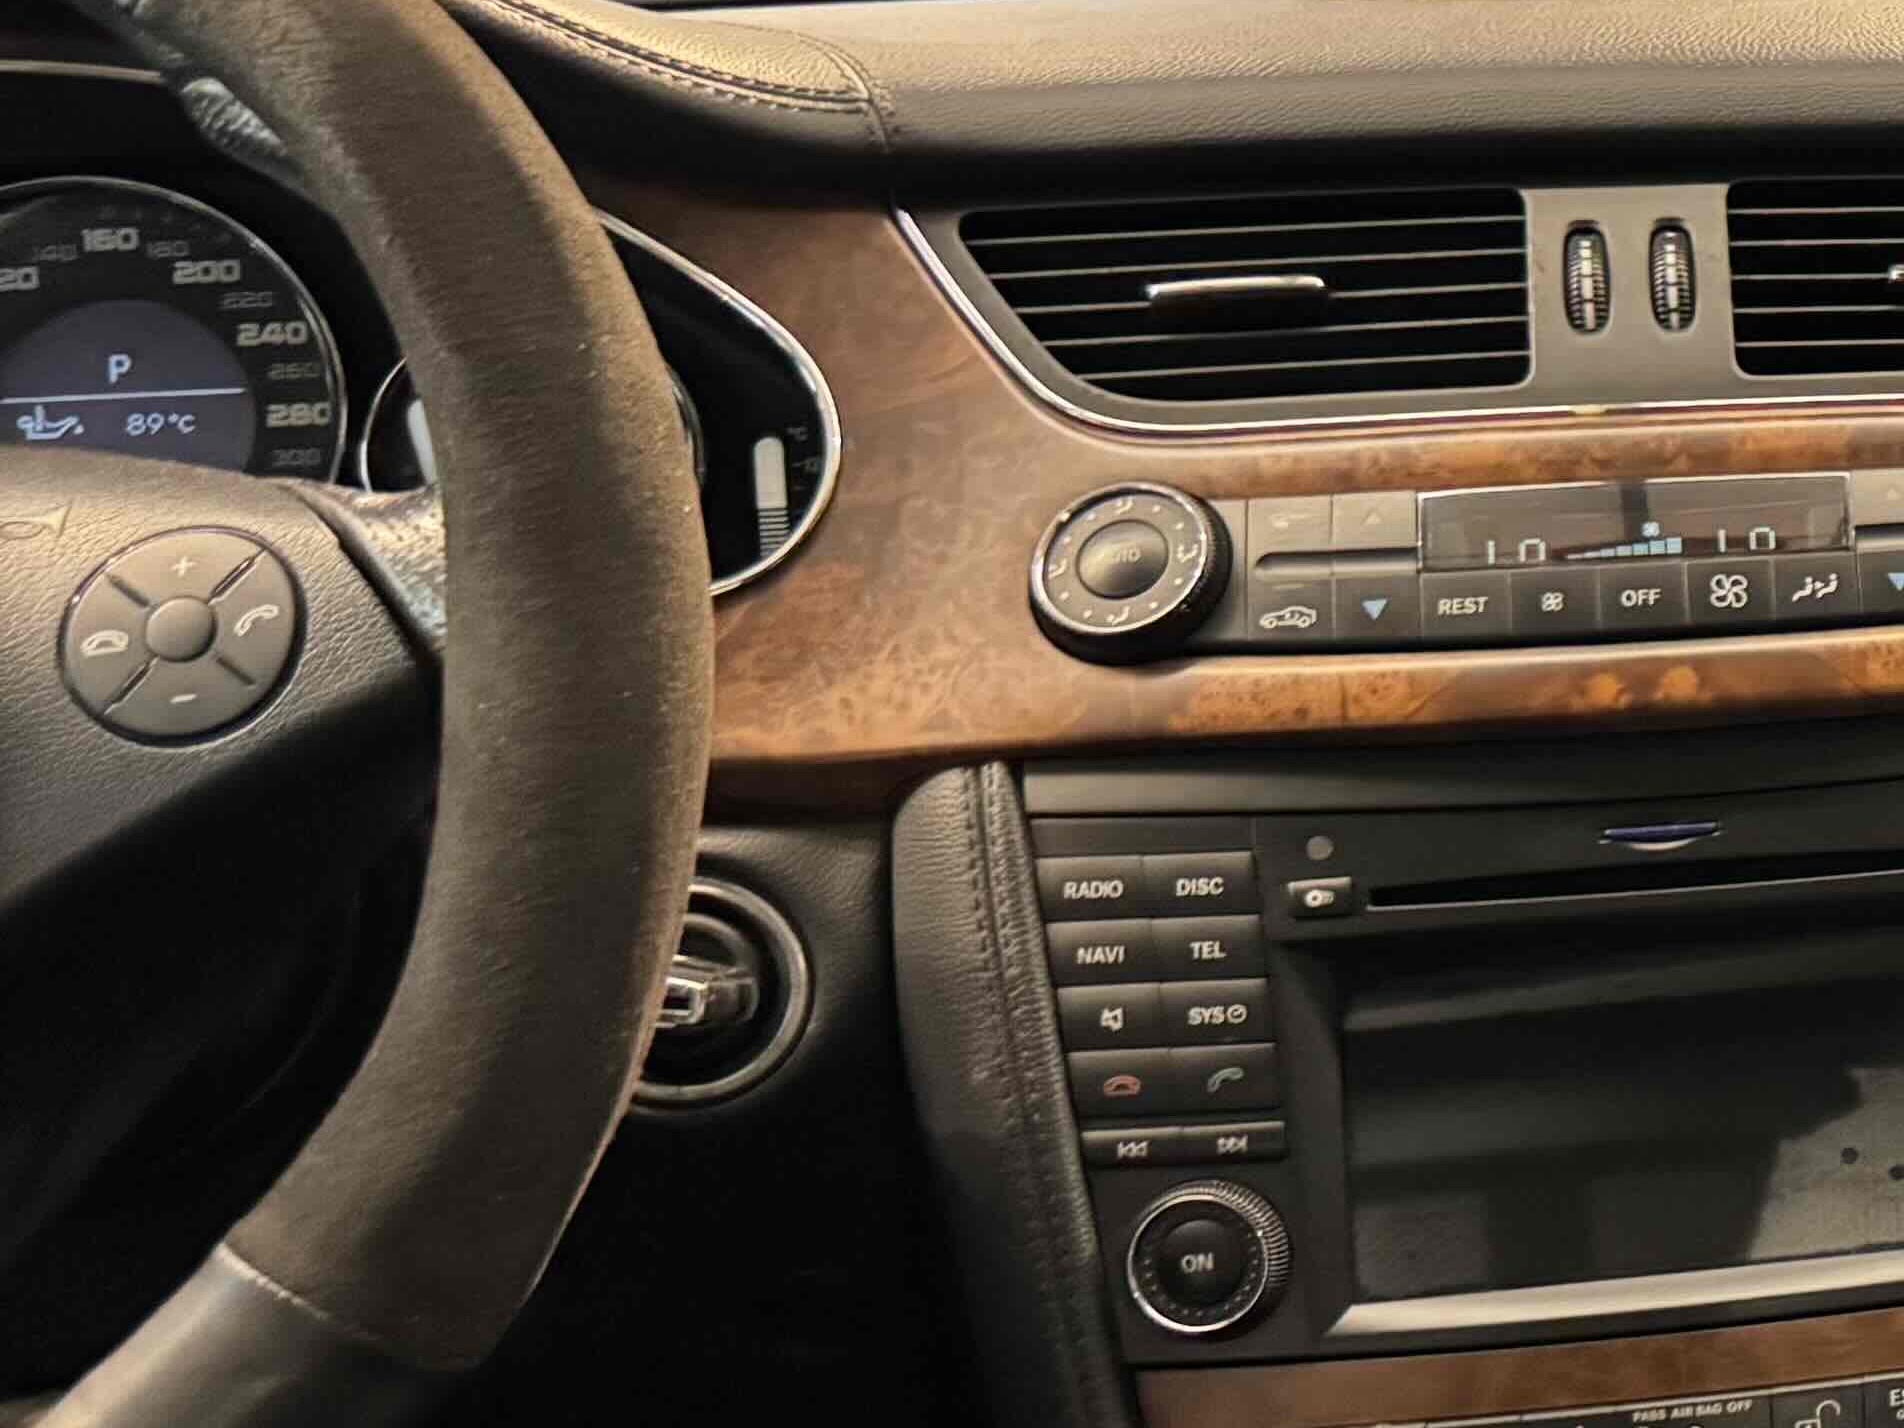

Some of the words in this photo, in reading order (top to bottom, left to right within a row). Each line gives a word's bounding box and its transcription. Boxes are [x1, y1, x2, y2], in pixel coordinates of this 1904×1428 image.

[81, 228, 140, 251] 160
[173, 260, 241, 284] 200
[237, 321, 308, 346] 240
[108, 354, 132, 384] P
[125, 413, 196, 436] 89°C
[266, 401, 332, 428] 280
[1437, 596, 1489, 616] REST
[1621, 587, 1662, 608] OFF
[1063, 879, 1124, 900] RADIO
[1175, 877, 1225, 897] DISC
[1076, 945, 1125, 965] NAVI
[1189, 941, 1227, 961] TEL
[1187, 1006, 1227, 1026] SYS
[1180, 1251, 1215, 1273] ON
[1631, 1408, 1667, 1423] PASS
[1726, 1399, 1754, 1414] OFF
